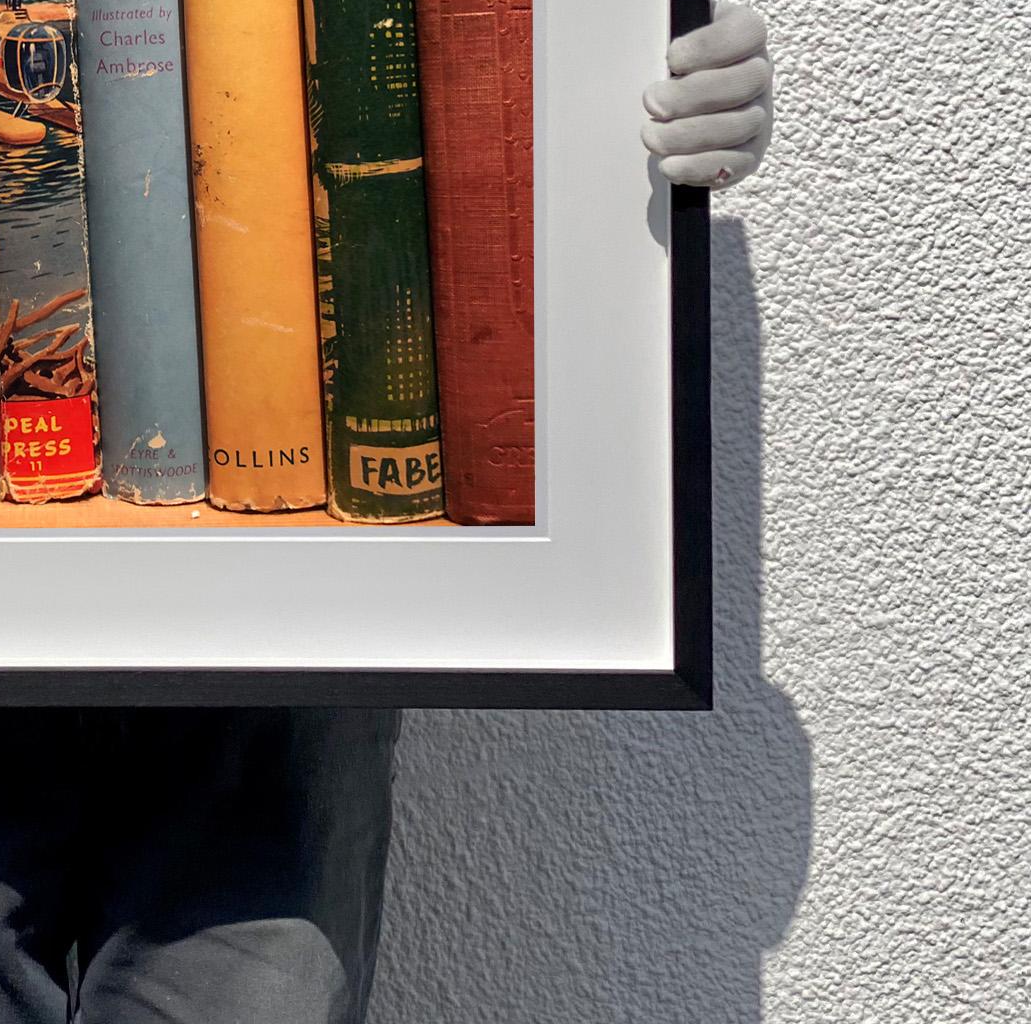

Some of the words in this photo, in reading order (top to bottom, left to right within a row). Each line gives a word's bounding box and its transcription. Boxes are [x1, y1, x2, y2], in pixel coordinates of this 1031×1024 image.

[91, 7, 154, 22] Illustrated
[159, 4, 173, 22] by
[99, 28, 166, 47] Charles
[96, 57, 175, 75] Ambrose
[2, 437, 72, 459] PRESS
[129, 447, 160, 461] EYRE
[207, 446, 311, 469] OLLINS
